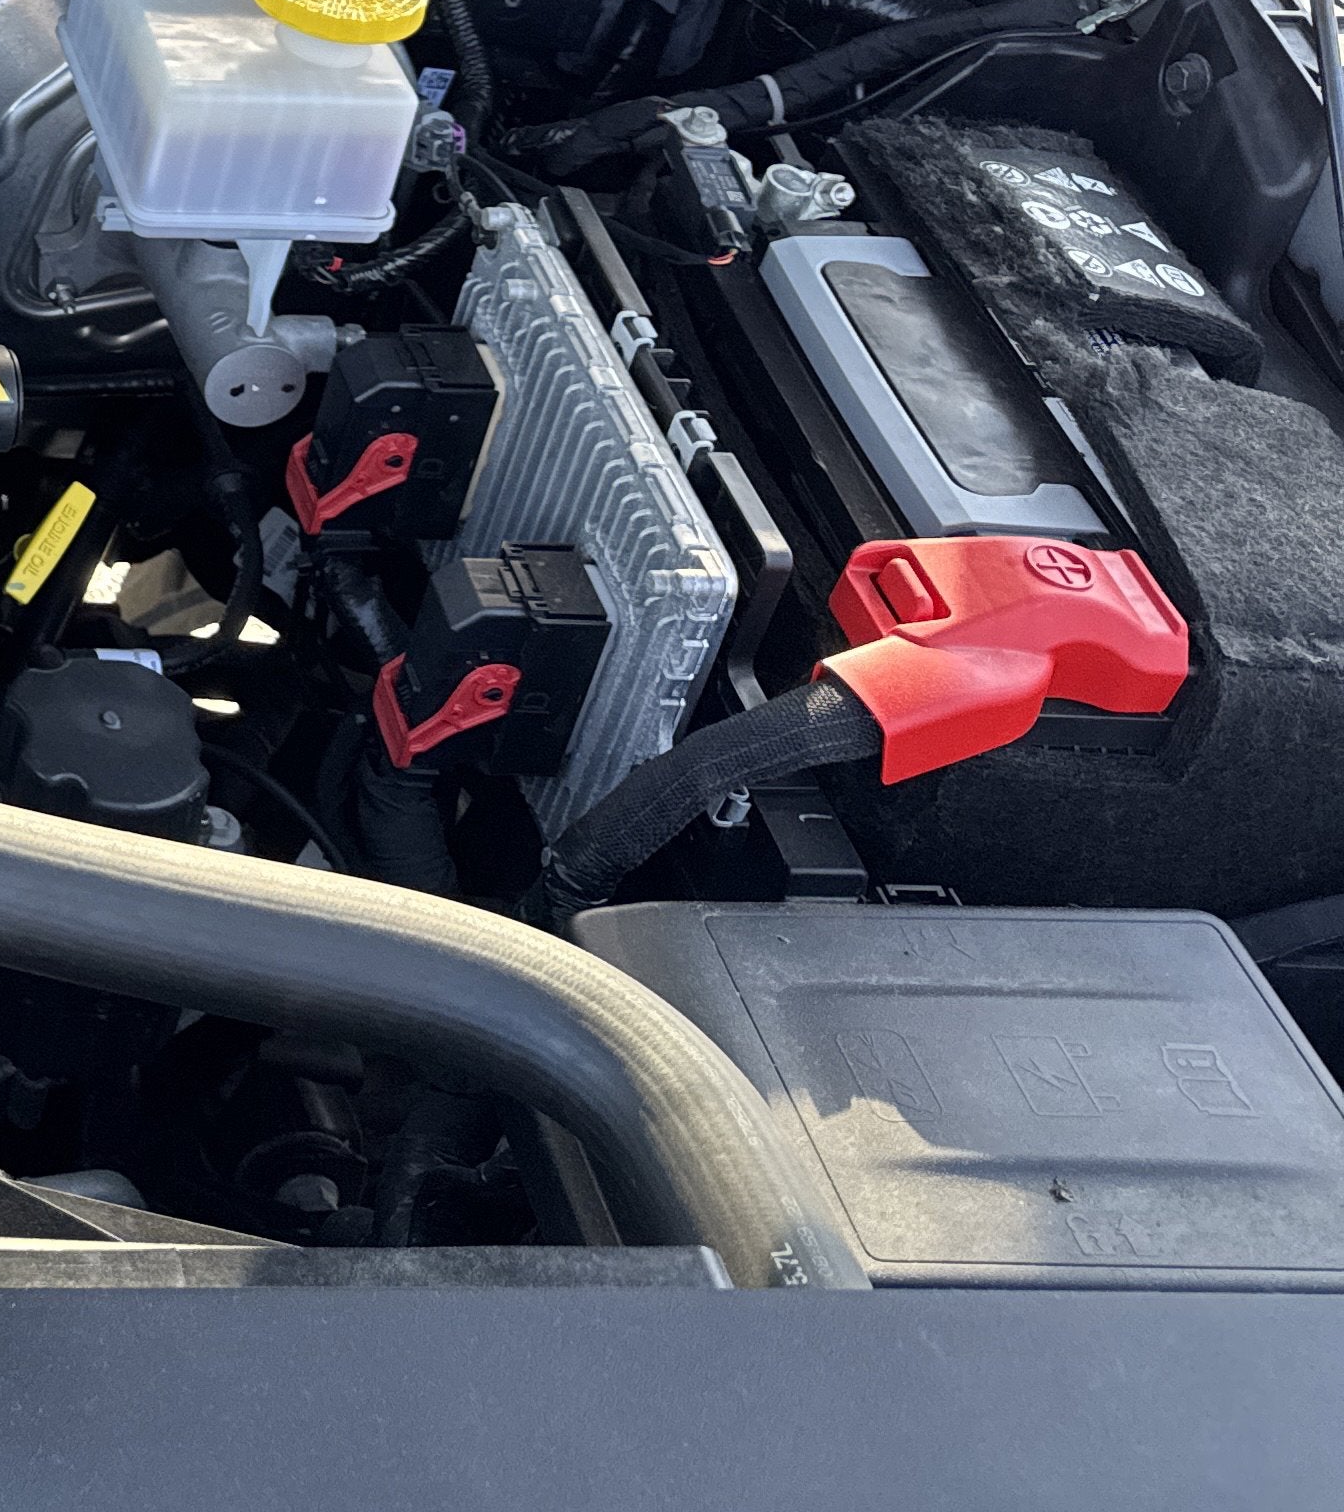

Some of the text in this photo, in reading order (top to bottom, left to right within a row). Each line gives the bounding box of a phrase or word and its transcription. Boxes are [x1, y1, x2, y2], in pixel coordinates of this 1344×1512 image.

[22, 502, 77, 578] ENGINE OIL
[770, 1240, 810, 1286] 5.7L
